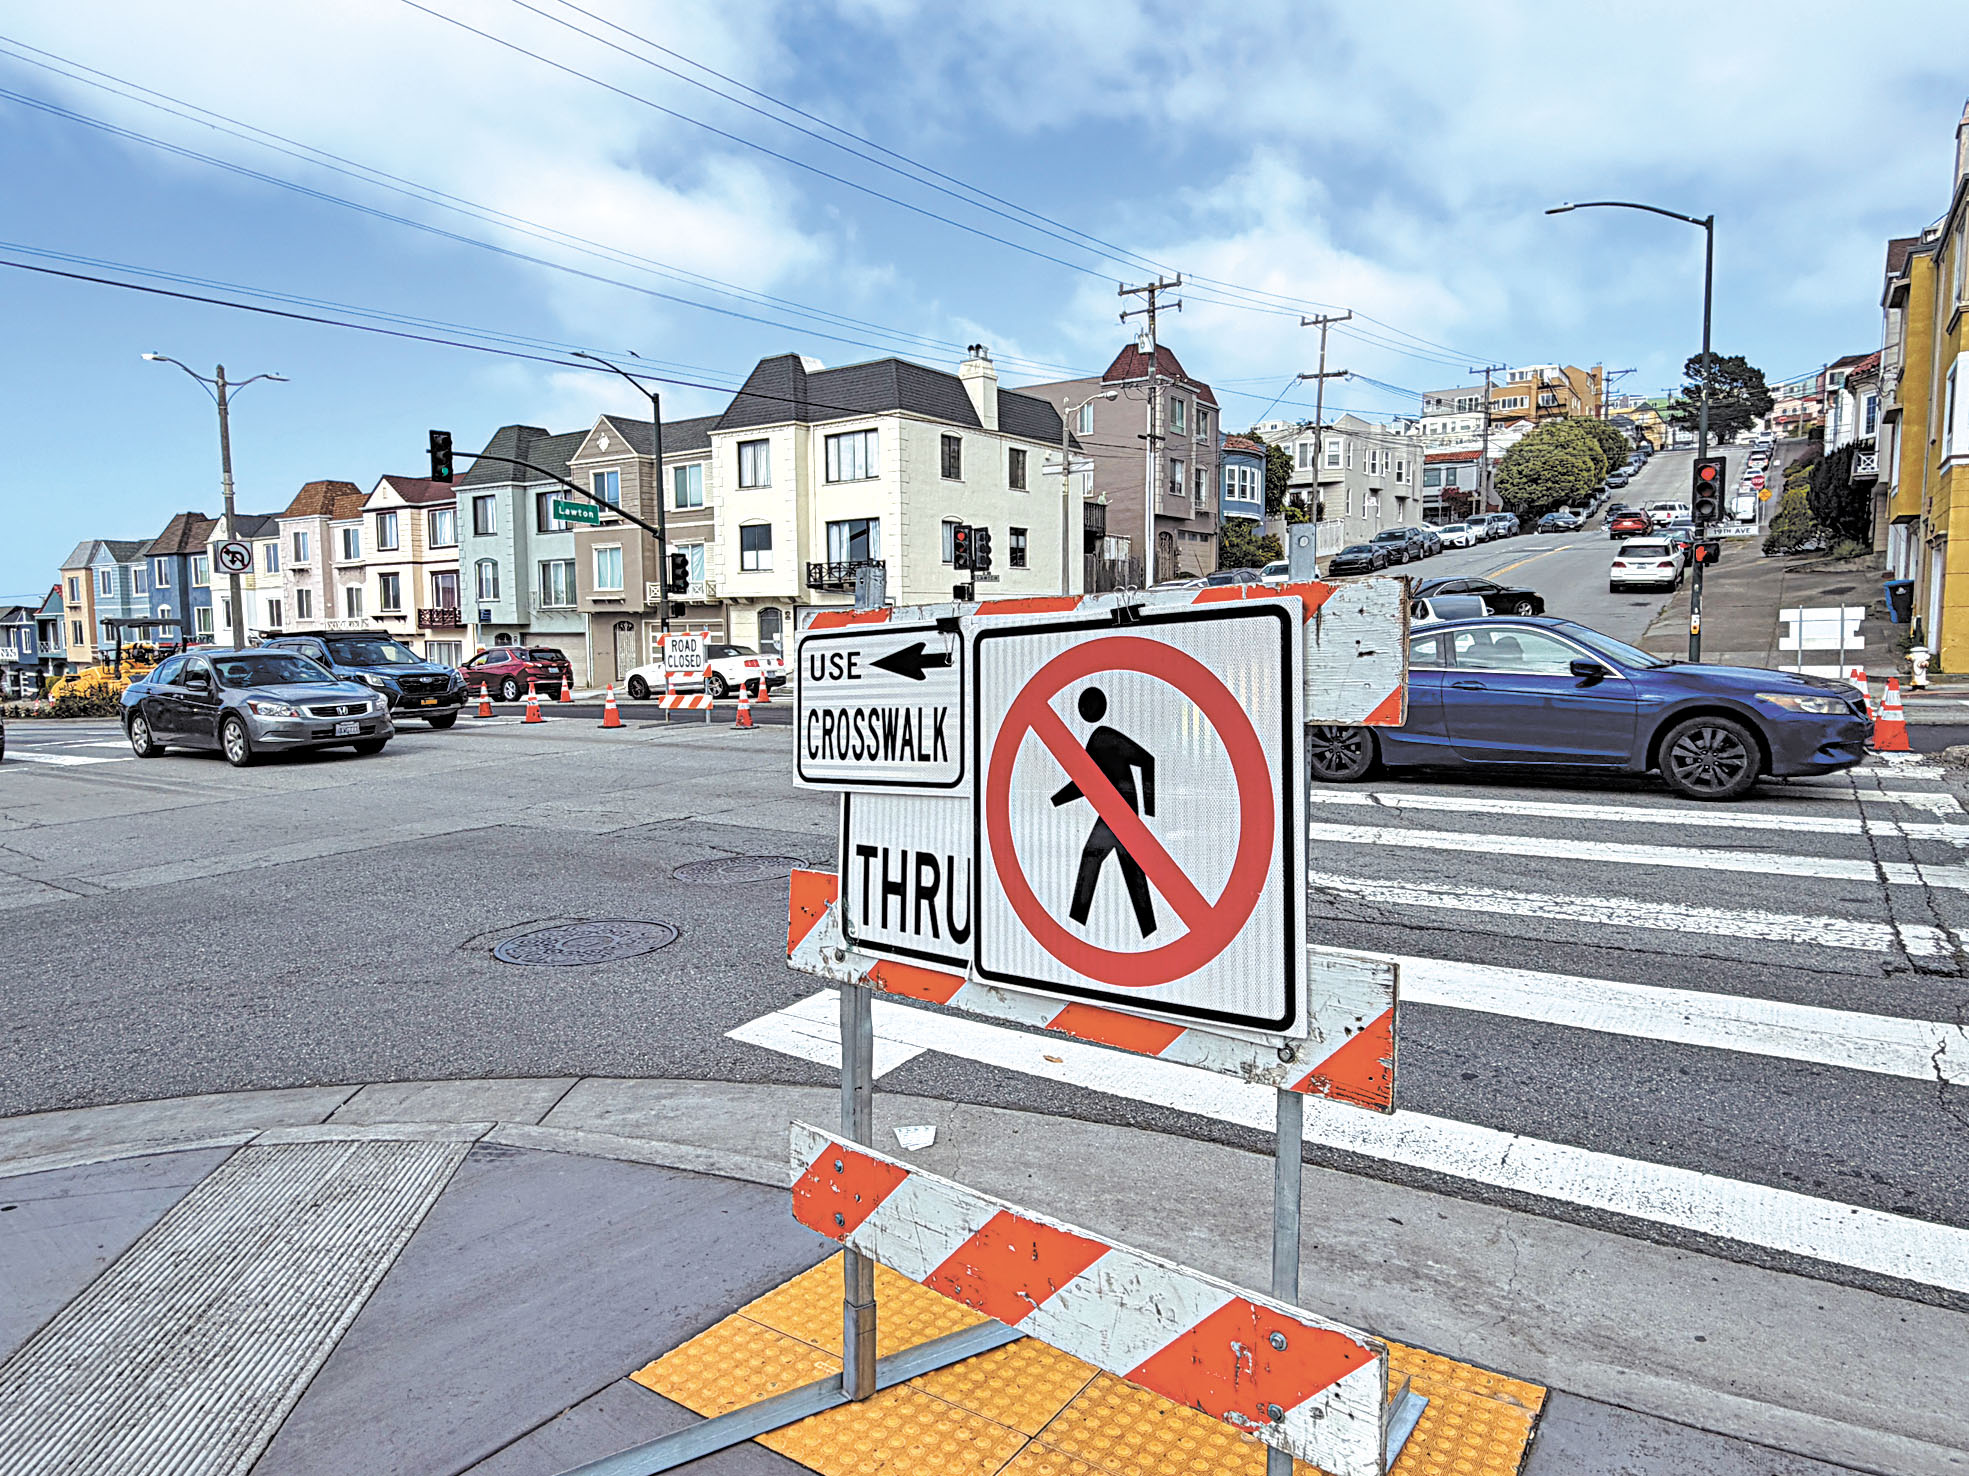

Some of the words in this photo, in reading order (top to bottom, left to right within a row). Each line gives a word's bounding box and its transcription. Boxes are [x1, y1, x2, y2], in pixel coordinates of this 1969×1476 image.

[559, 506, 594, 518] Lawton
[671, 639, 697, 652] ROAD
[668, 654, 702, 668] CLOSED
[810, 652, 862, 681] USE
[807, 706, 948, 762] CROSSWALK
[856, 844, 971, 945] THRU
